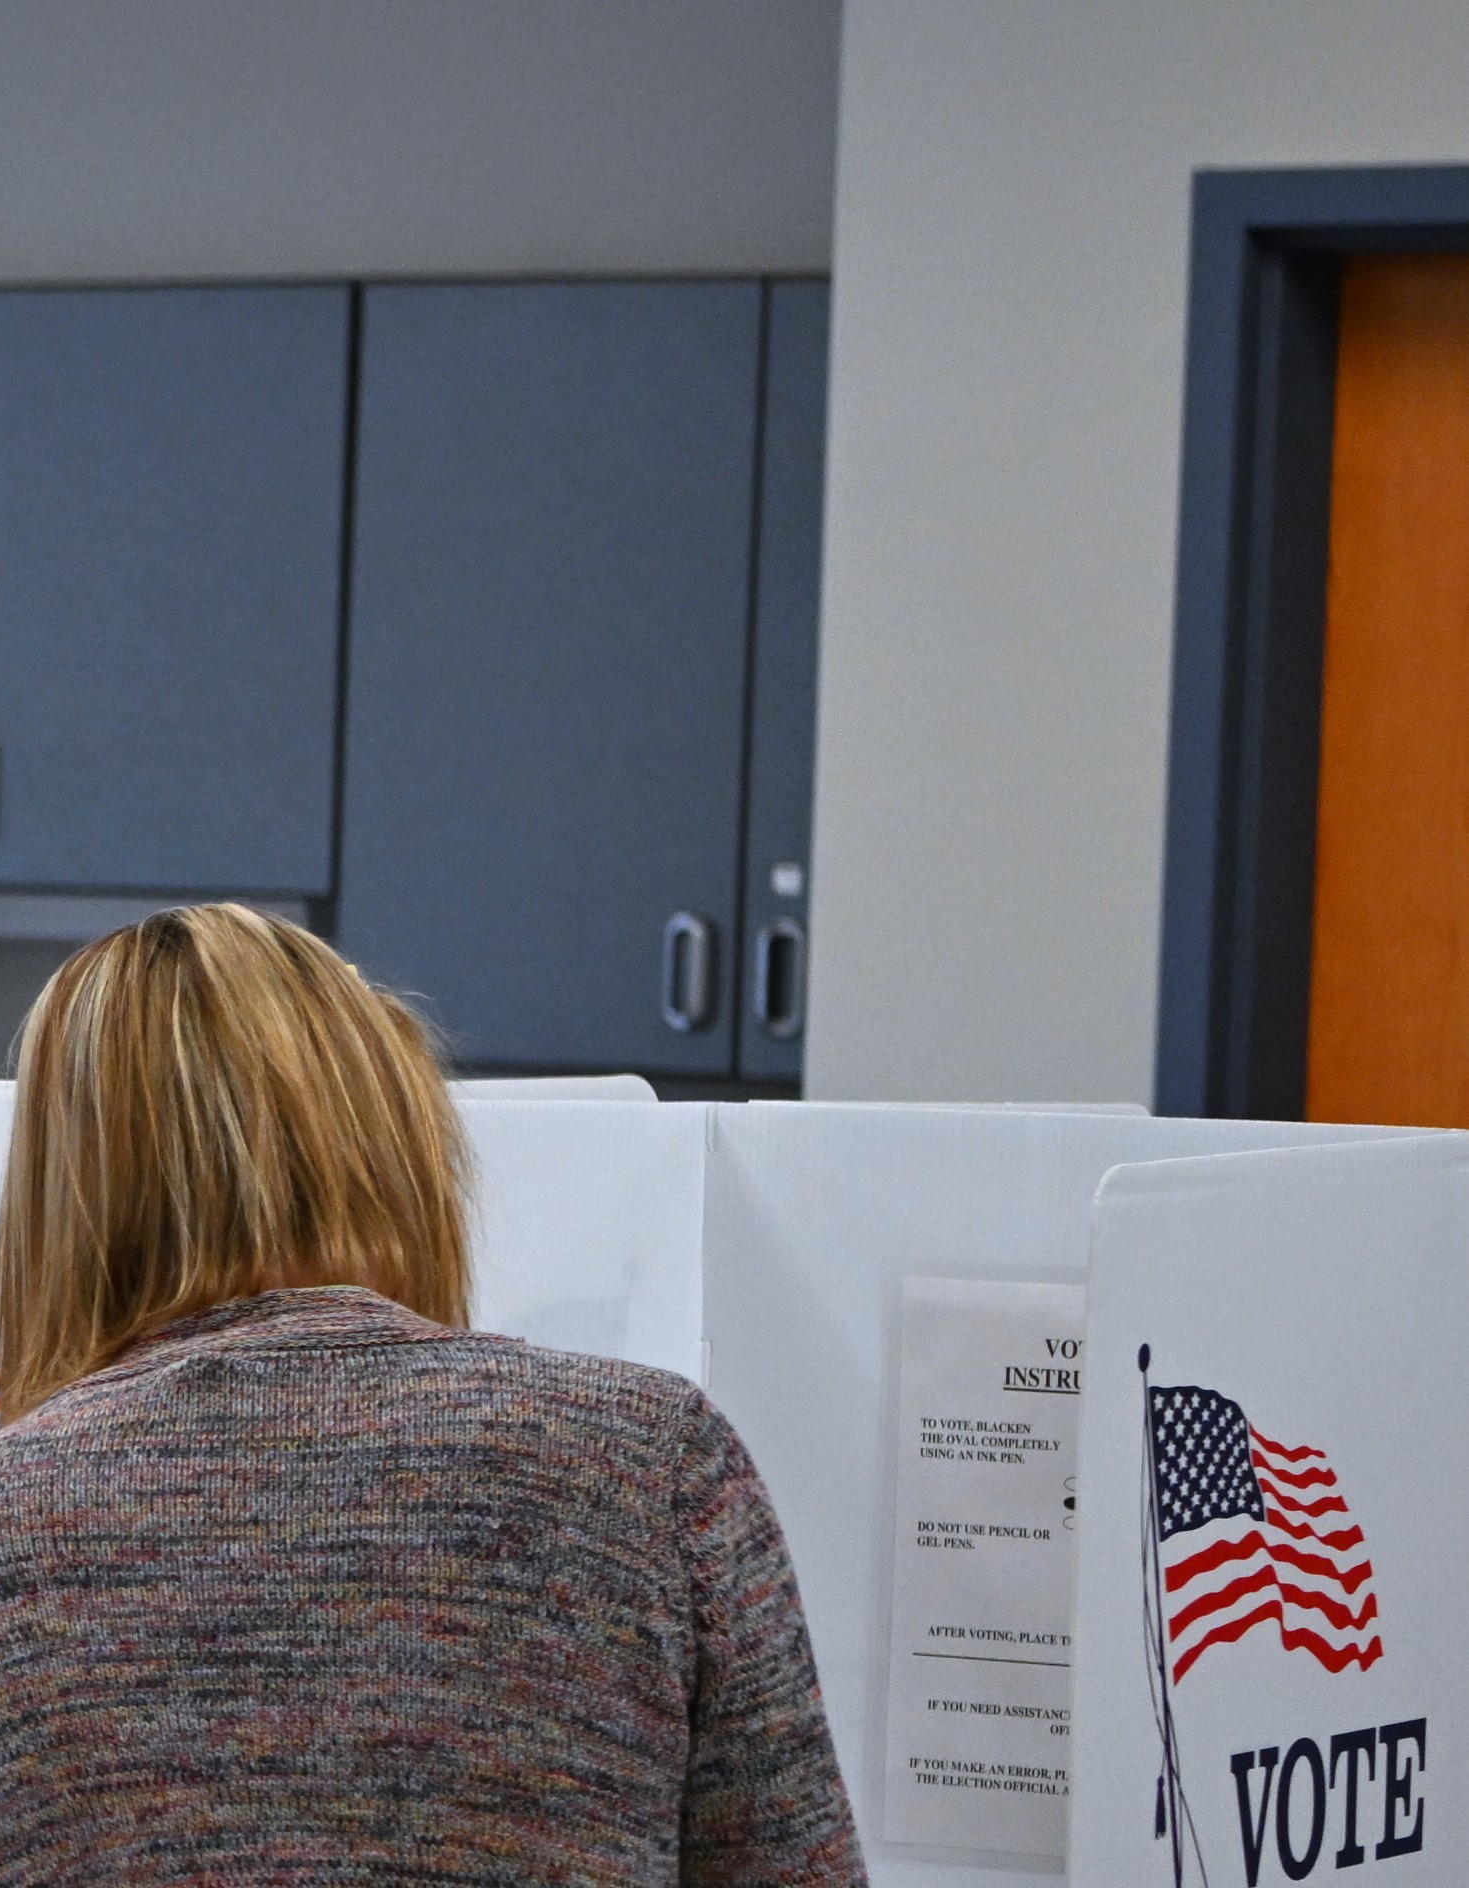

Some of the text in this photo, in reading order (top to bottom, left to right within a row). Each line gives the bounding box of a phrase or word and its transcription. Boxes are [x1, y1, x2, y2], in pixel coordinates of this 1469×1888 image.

[1046, 1338, 1083, 1359] VO
[921, 1418, 1032, 1434] TO VOTE, BLACKEN
[920, 1432, 1061, 1451] THE OVAL COMPLETELY
[920, 1447, 1025, 1464] USING AN INK PEN.
[917, 1521, 1051, 1540] DO NOT USE PENCIL OR
[917, 1536, 975, 1550] GEL PENS.
[928, 1625, 965, 1639] AFTER
[969, 1628, 1017, 1643] VOTING,
[1019, 1632, 1057, 1645] PLACE
[928, 1699, 1071, 1721] IF YOU NEED ASSISTANC
[909, 1757, 920, 1769] IF
[924, 1759, 948, 1770] YOU
[951, 1761, 985, 1774] MAKE
[989, 1764, 1005, 1775] AN
[1008, 1765, 1052, 1780] ERROR,
[915, 1773, 938, 1785] THE
[942, 1775, 1001, 1790] ELECTION
[1004, 1780, 1059, 1796] OFFICIAL
[1230, 1717, 1427, 1888] VOTE
